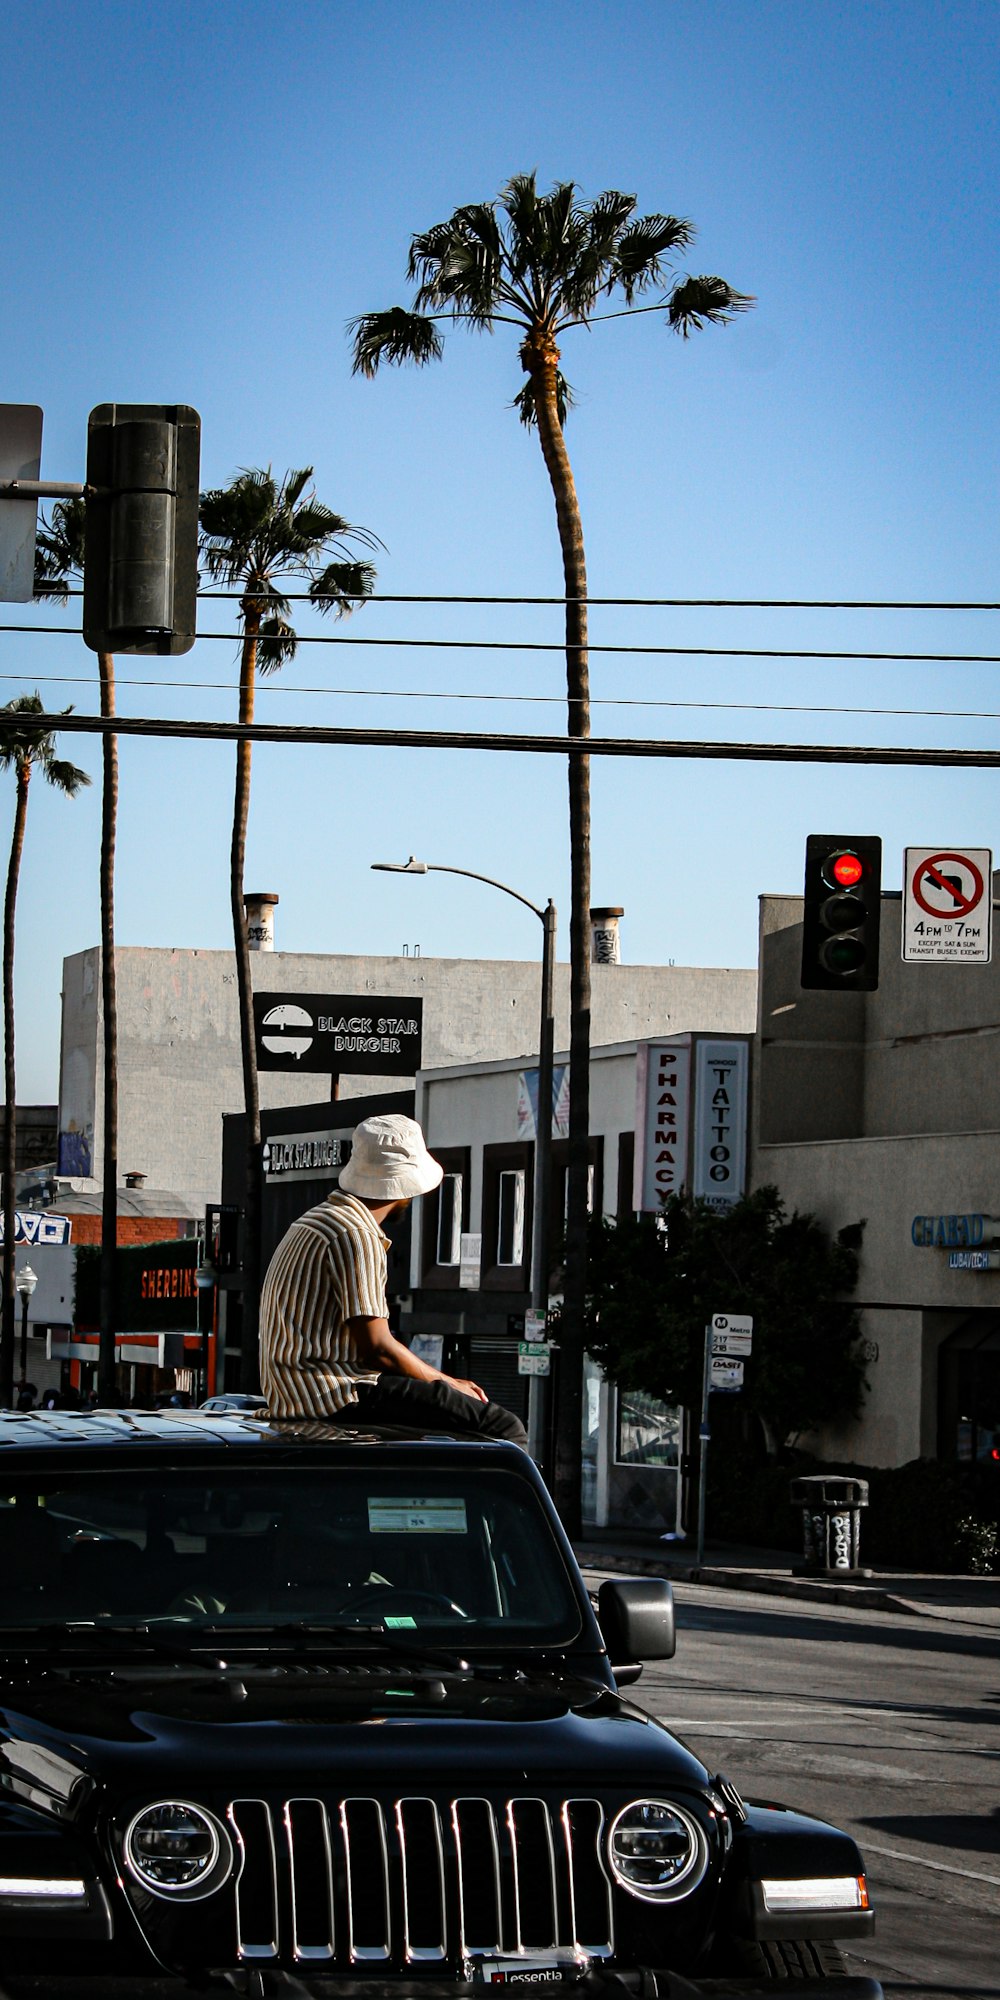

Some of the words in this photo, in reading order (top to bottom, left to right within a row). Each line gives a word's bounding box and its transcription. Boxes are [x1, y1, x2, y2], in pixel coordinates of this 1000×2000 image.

[914, 921, 941, 936] 4PM
[955, 922, 980, 937] 7PM
[318, 1016, 372, 1033] BLACK
[377, 1018, 418, 1035] STAR
[334, 1035, 401, 1053] BURGER
[655, 1054, 677, 1200] PHARMACY
[709, 1068, 731, 1182] TATTOO
[271, 1143, 294, 1171] BLACK
[295, 1142, 313, 1168] STAR
[313, 1139, 342, 1167] BURGER
[912, 1214, 983, 1247] CHABAD
[713, 1335, 728, 1343] 217
